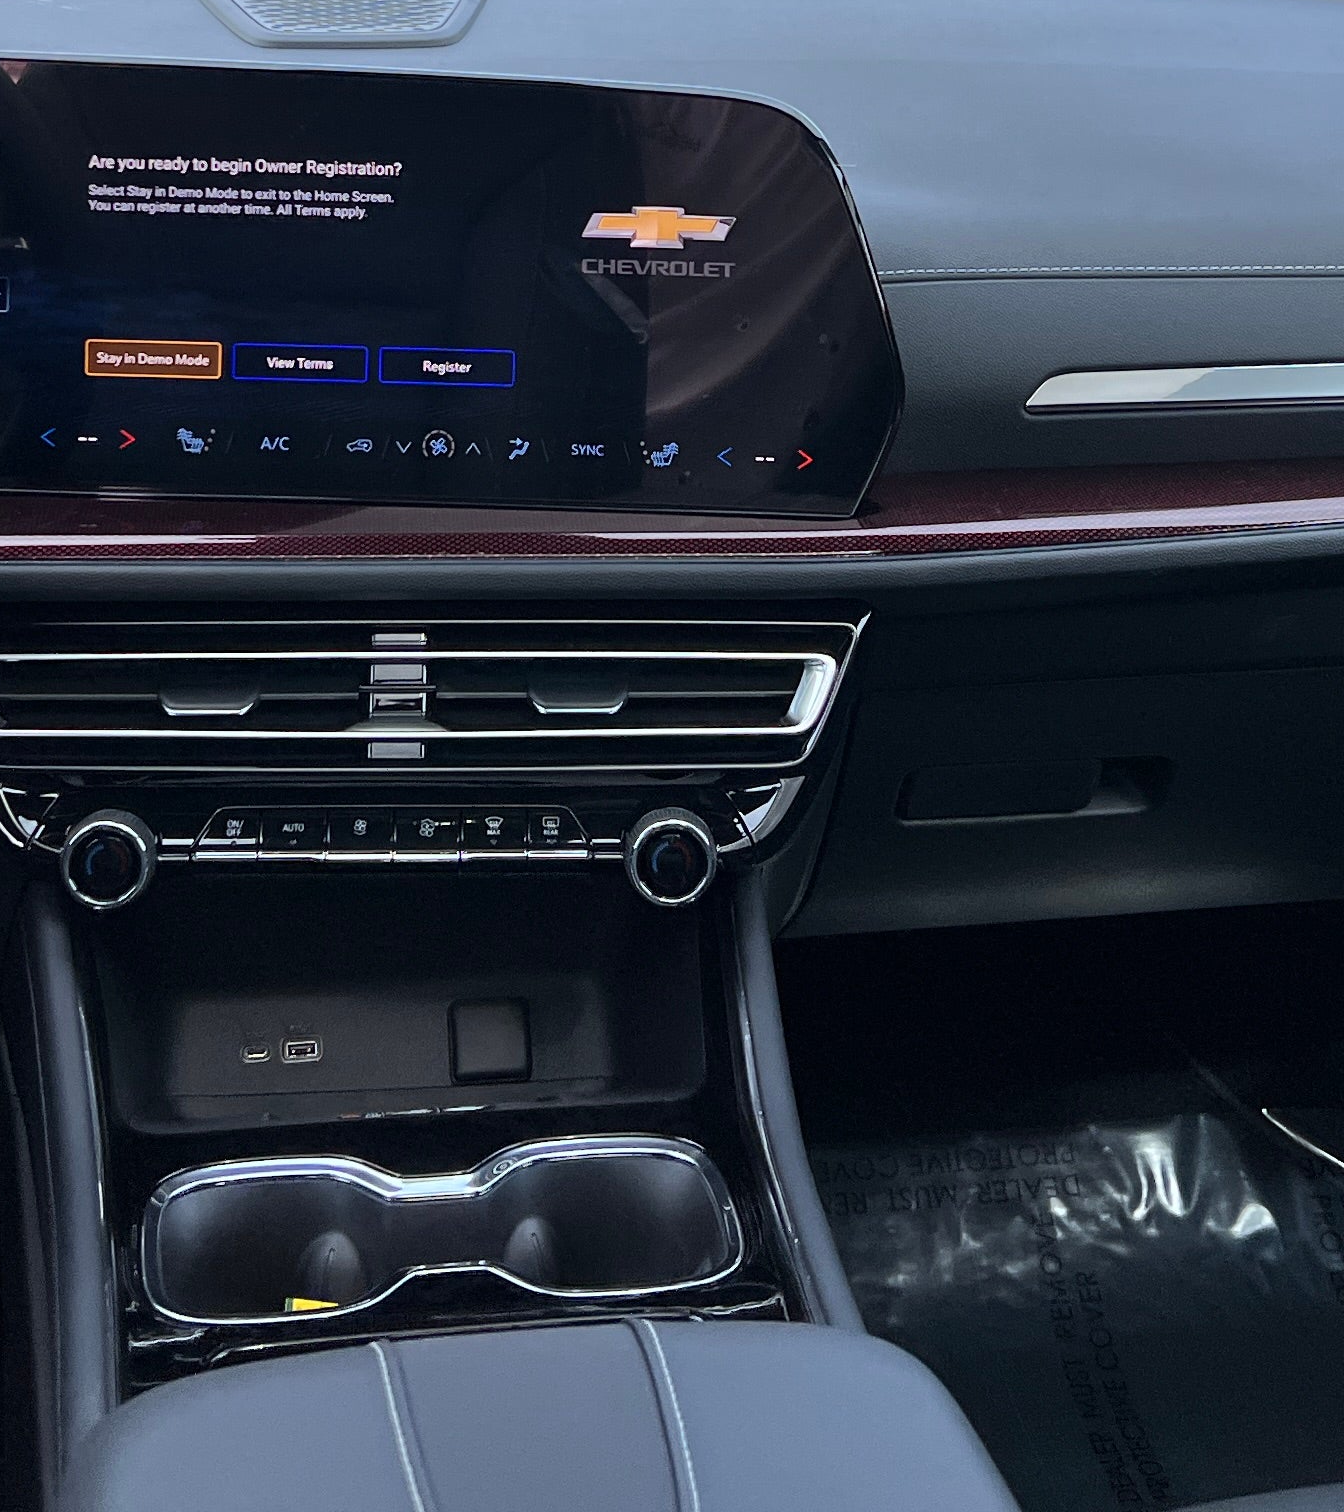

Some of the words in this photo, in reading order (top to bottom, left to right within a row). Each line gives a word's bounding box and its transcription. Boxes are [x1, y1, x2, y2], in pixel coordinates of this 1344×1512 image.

[88, 154, 116, 170] Are
[116, 157, 146, 173] you
[148, 156, 190, 174] ready
[192, 157, 209, 172] to
[210, 157, 252, 176] begin
[255, 159, 304, 174] Owner
[306, 159, 403, 178] Registration?
[88, 184, 125, 197] Select
[126, 185, 153, 199] Stay
[155, 185, 166, 198] in
[168, 186, 203, 198] Demo
[204, 187, 239, 199] Mode
[240, 188, 254, 200] to
[254, 189, 277, 201] exit
[278, 189, 292, 201] to
[293, 189, 313, 202] the
[314, 190, 350, 202] Home
[351, 191, 395, 204] Screen.
[88, 199, 112, 211] You
[113, 201, 136, 212] can
[137, 201, 182, 215] register
[183, 202, 196, 214] at
[197, 202, 242, 214] another
[244, 203, 275, 216] time.
[276, 204, 293, 216] All
[294, 204, 331, 217] Terms
[333, 205, 369, 220] apply.
[581, 257, 736, 279] CHEVROLET
[96, 351, 123, 367] Stay
[123, 352, 136, 365] in
[137, 352, 174, 366] Demo
[175, 354, 211, 367] Mode
[265, 356, 296, 370] View
[296, 357, 334, 370] Terms
[422, 360, 473, 376] Register
[260, 434, 291, 452] A/C
[570, 442, 606, 459] SYNC
[281, 822, 305, 833] AUTO
[814, 1154, 900, 1183] COVE
[909, 1143, 1076, 1177] PROTECTIVE
[885, 1184, 957, 1212] MUST
[976, 1173, 1081, 1205] DEALER
